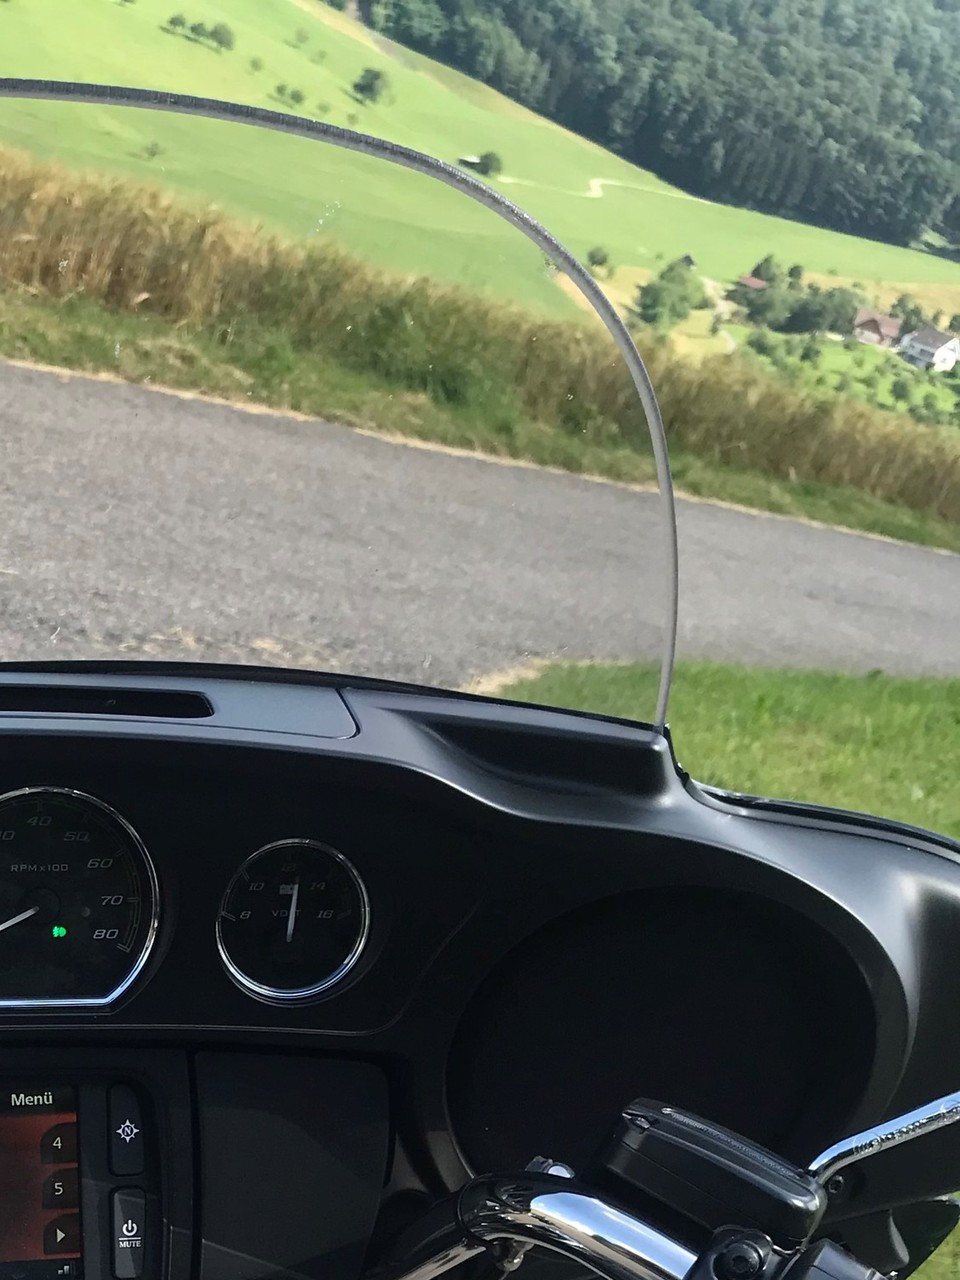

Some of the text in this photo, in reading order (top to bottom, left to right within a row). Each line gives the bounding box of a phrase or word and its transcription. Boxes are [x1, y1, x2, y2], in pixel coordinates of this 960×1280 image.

[26, 816, 52, 826] 40
[63, 831, 89, 842] 50
[87, 859, 113, 869] 60
[101, 896, 123, 906] 70
[240, 911, 252, 920] 8
[93, 929, 119, 940] 80
[10, 1091, 54, 1107] Menü
[52, 1137, 62, 1149] 4
[54, 1182, 63, 1195] 5
